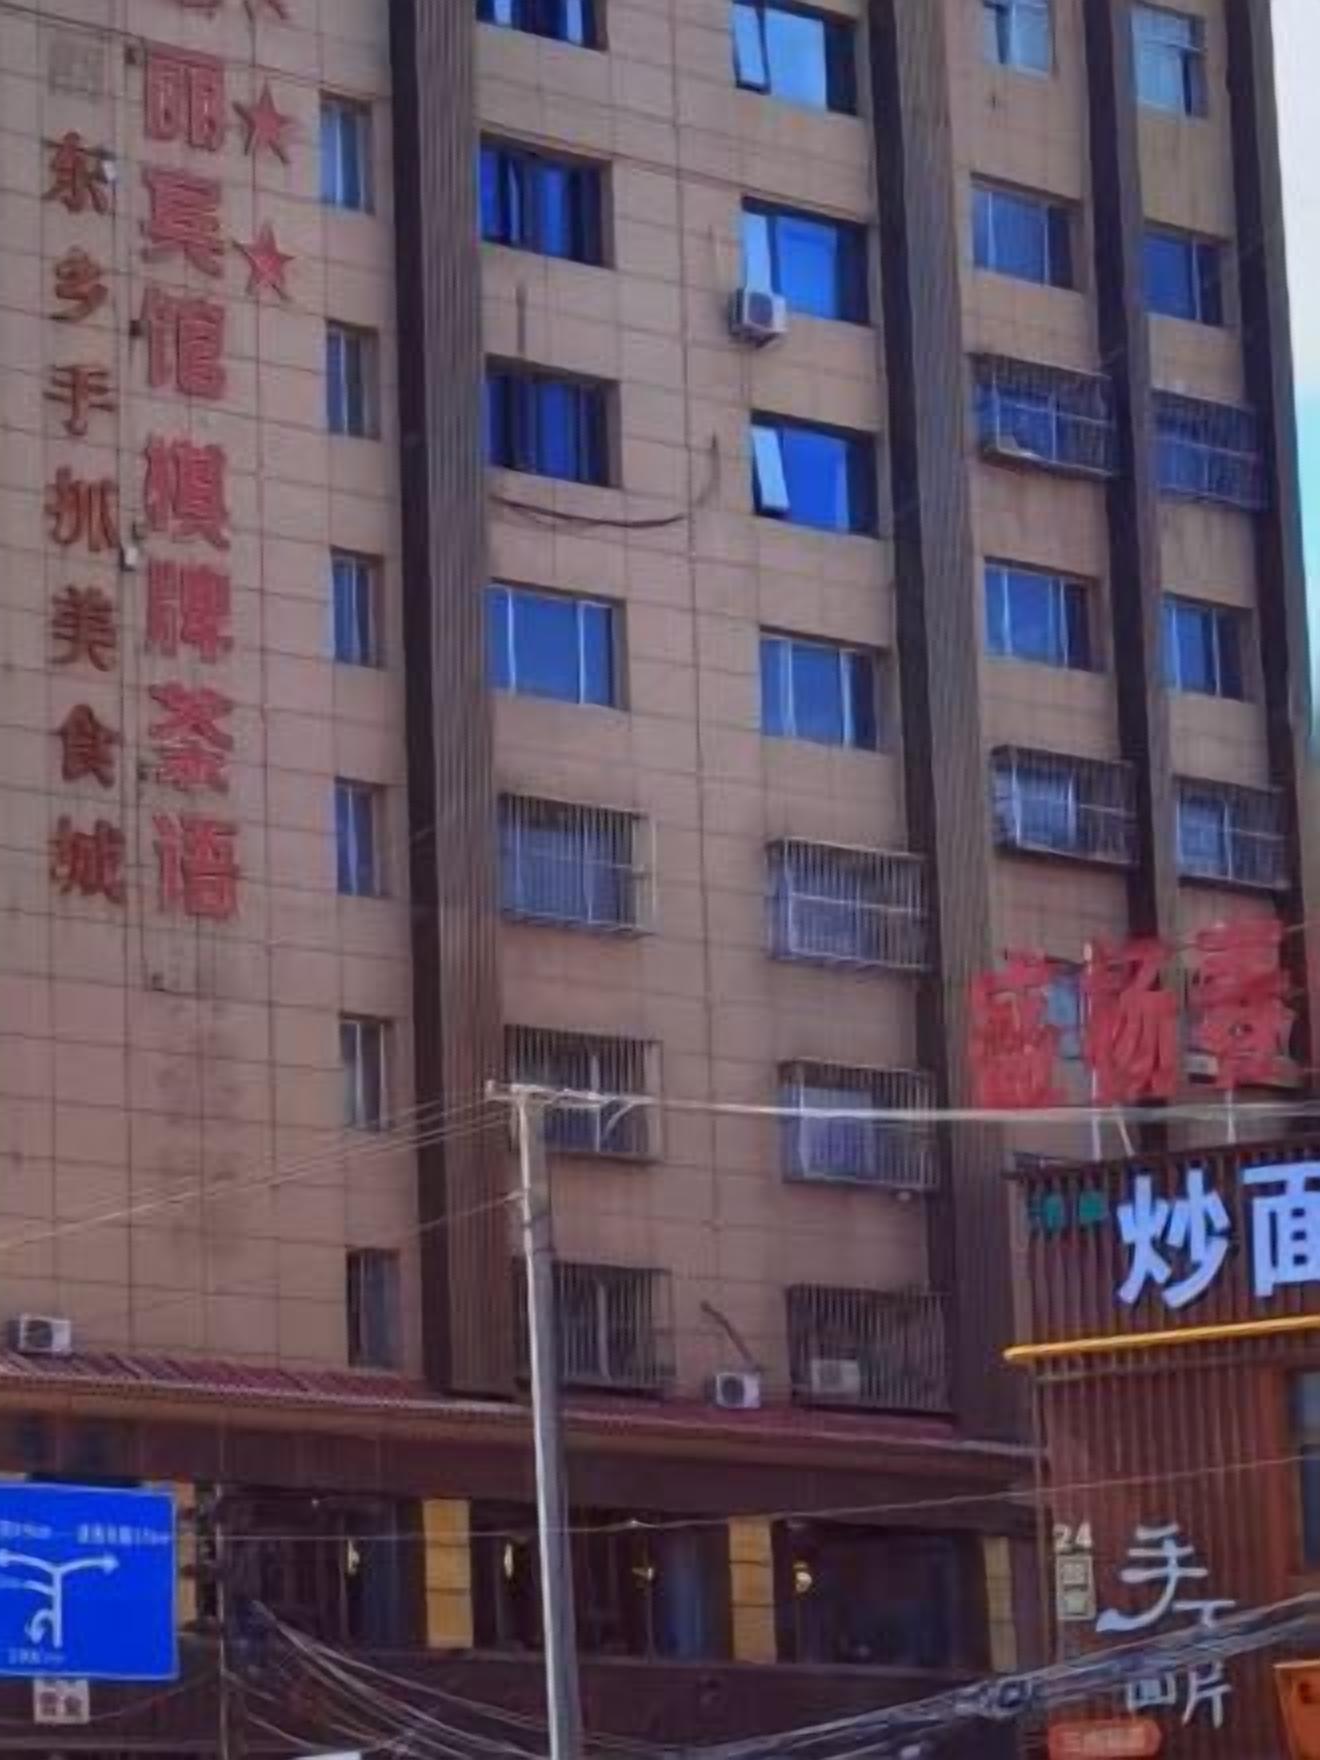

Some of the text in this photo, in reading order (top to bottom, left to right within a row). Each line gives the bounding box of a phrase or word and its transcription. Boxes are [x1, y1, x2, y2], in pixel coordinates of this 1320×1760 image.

[142, 0, 225, 400] 丽宾馆
[41, 131, 127, 905] 东乡手抓美食城
[1116, 1158, 1320, 1309] 炒面
